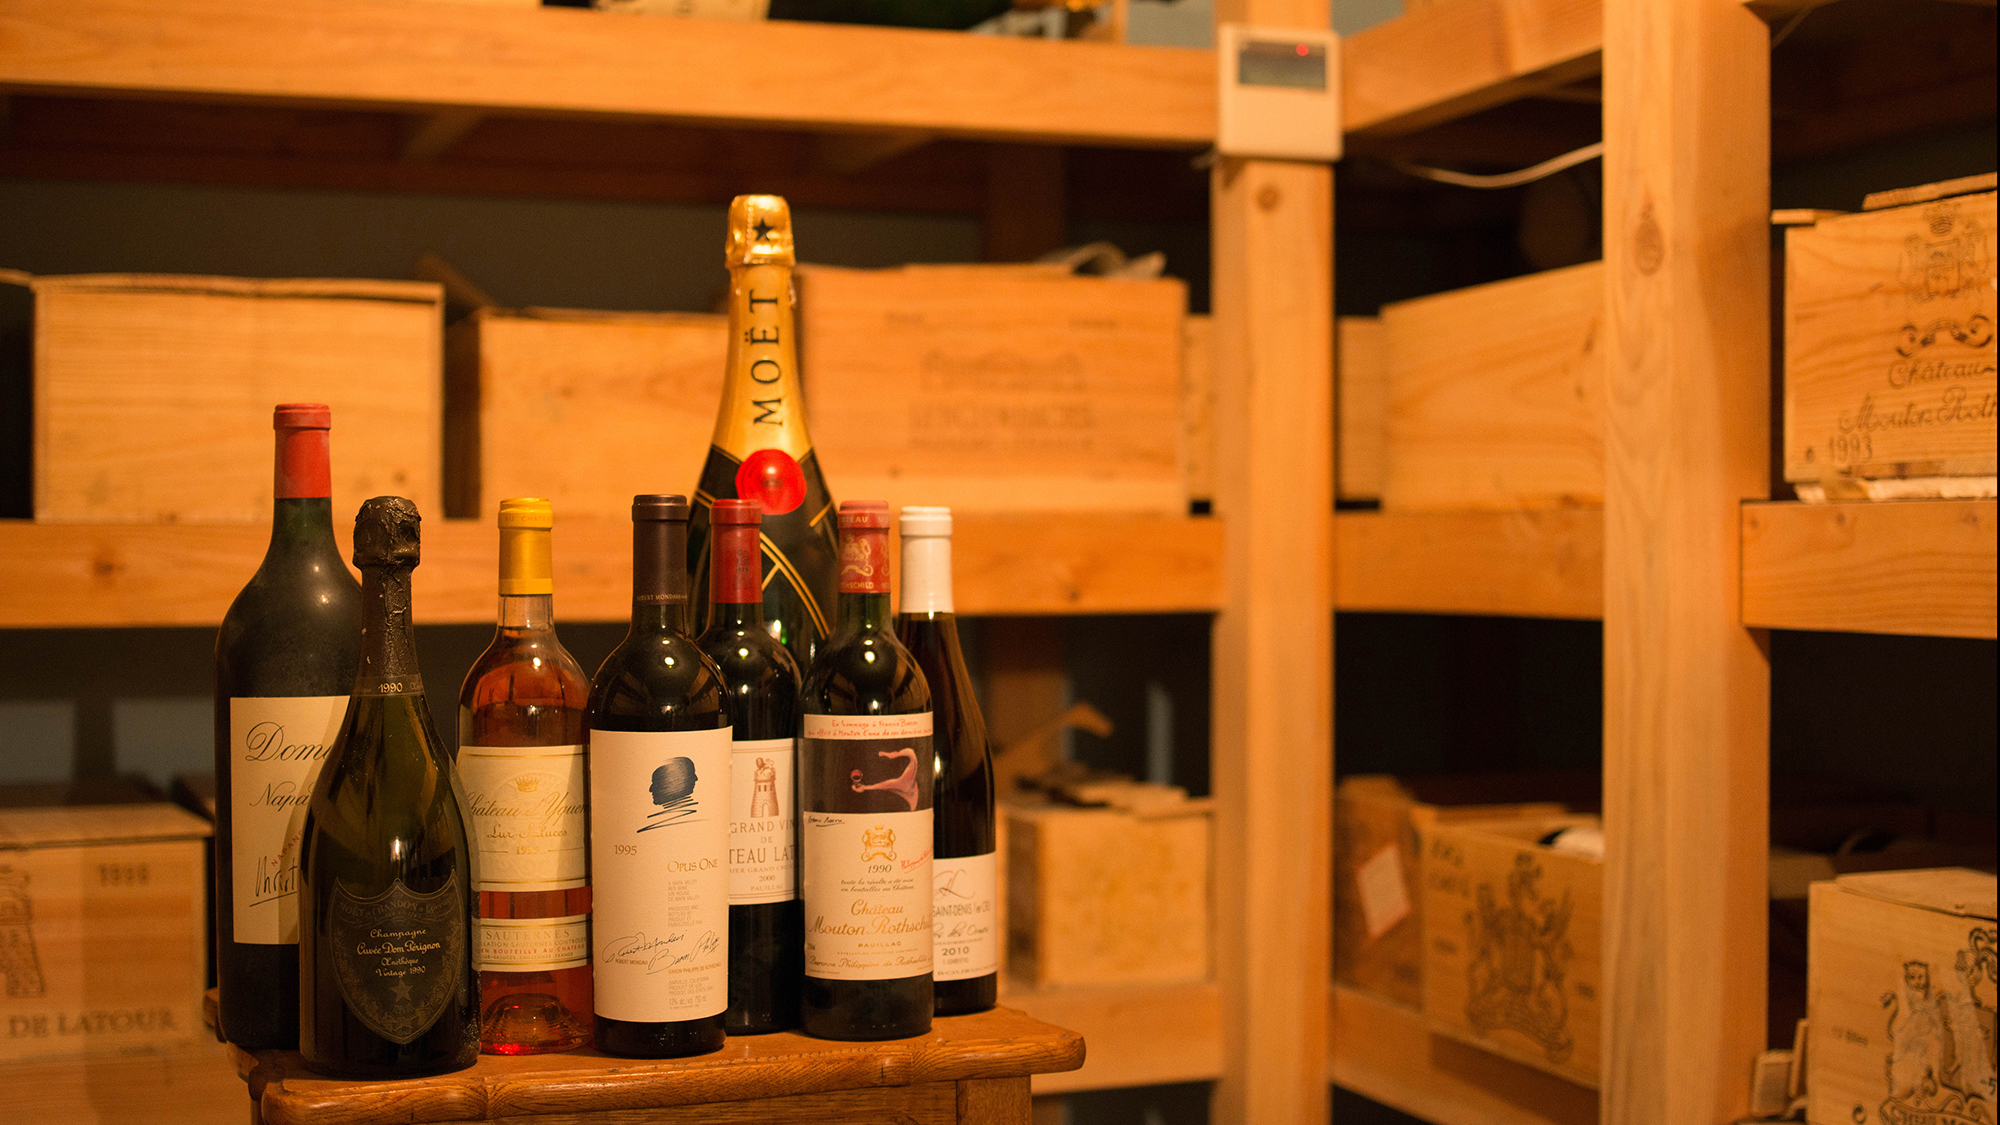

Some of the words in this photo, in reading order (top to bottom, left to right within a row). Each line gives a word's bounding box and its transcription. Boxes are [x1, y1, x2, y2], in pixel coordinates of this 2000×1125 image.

[745, 289, 783, 426] MOËT
[378, 682, 404, 693] 1990
[249, 780, 310, 813] Napa
[760, 836, 773, 844] DE
[614, 844, 638, 856] 1995
[867, 864, 892, 874] 1990
[850, 899, 904, 916] Château
[806, 915, 866, 935] Mouton
[370, 928, 427, 940] Champagne
[486, 929, 570, 940] SAUTERNES
[357, 942, 381, 955] Cuvée
[382, 941, 404, 954] Dom
[942, 946, 970, 957] 2010
[57, 1007, 178, 1036] LATOUR
